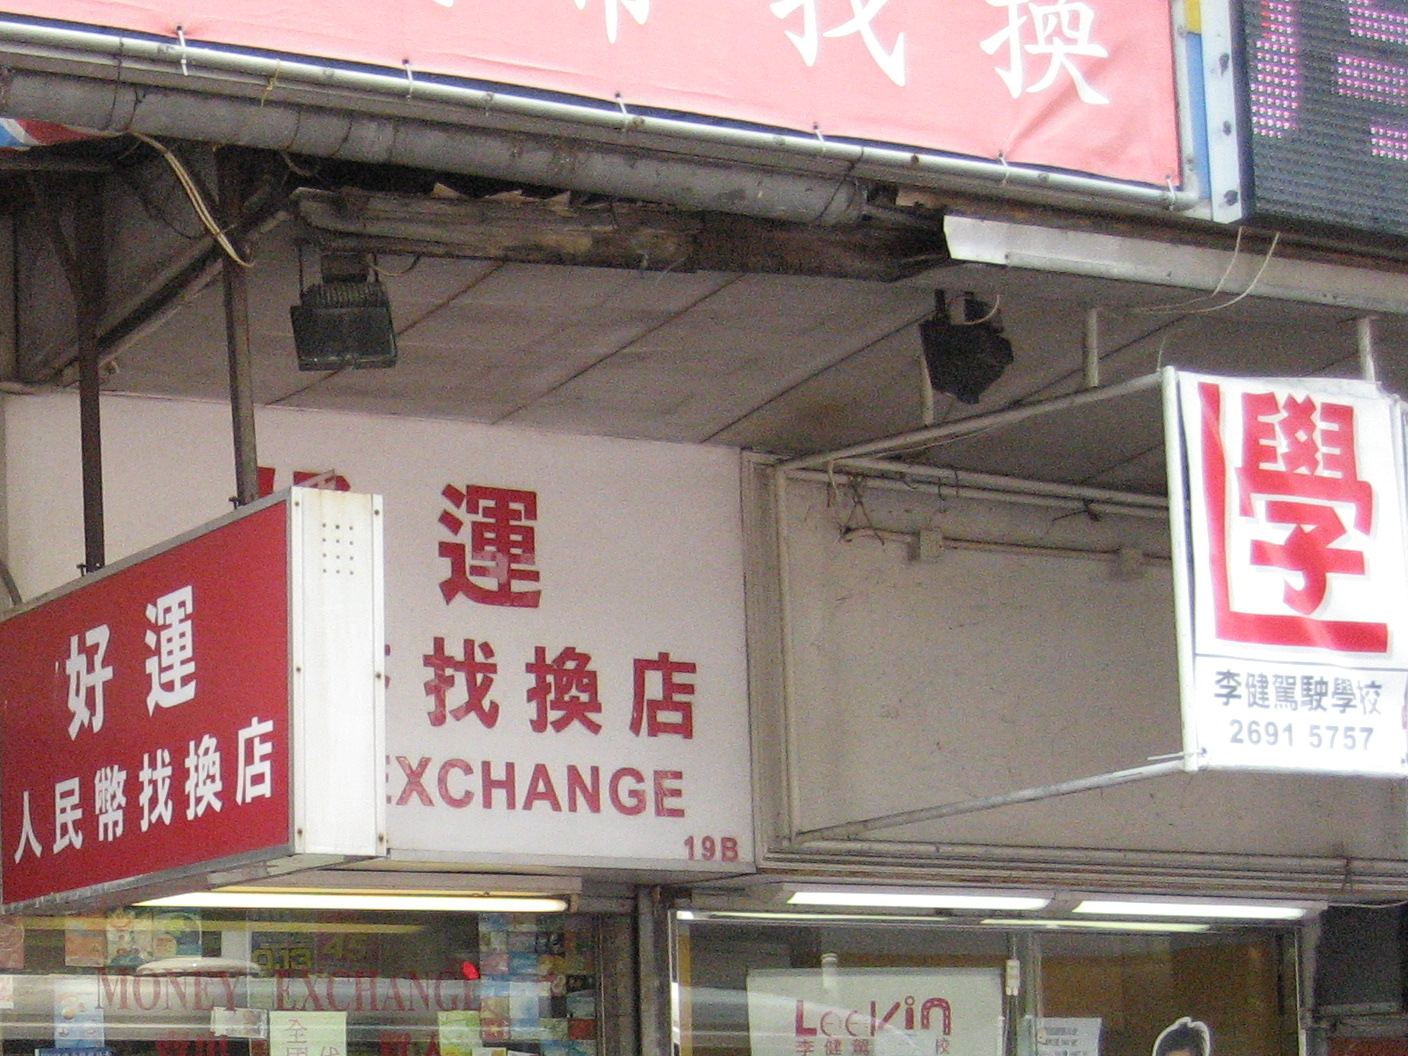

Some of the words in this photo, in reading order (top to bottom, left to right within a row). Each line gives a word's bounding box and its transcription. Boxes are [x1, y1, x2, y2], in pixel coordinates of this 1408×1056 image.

[1234, 391, 1373, 615] 學
[65, 585, 197, 741] 好運
[423, 637, 697, 739] 找換店
[1214, 669, 1383, 716] 李健駕駛學校
[1229, 719, 1294, 747] 2691
[1309, 725, 1374, 751] 5757
[14, 717, 274, 863] 人民幣找換店
[386, 755, 685, 818] XCHANGE
[685, 835, 739, 863] 19B
[96, 967, 239, 1012] MONEY
